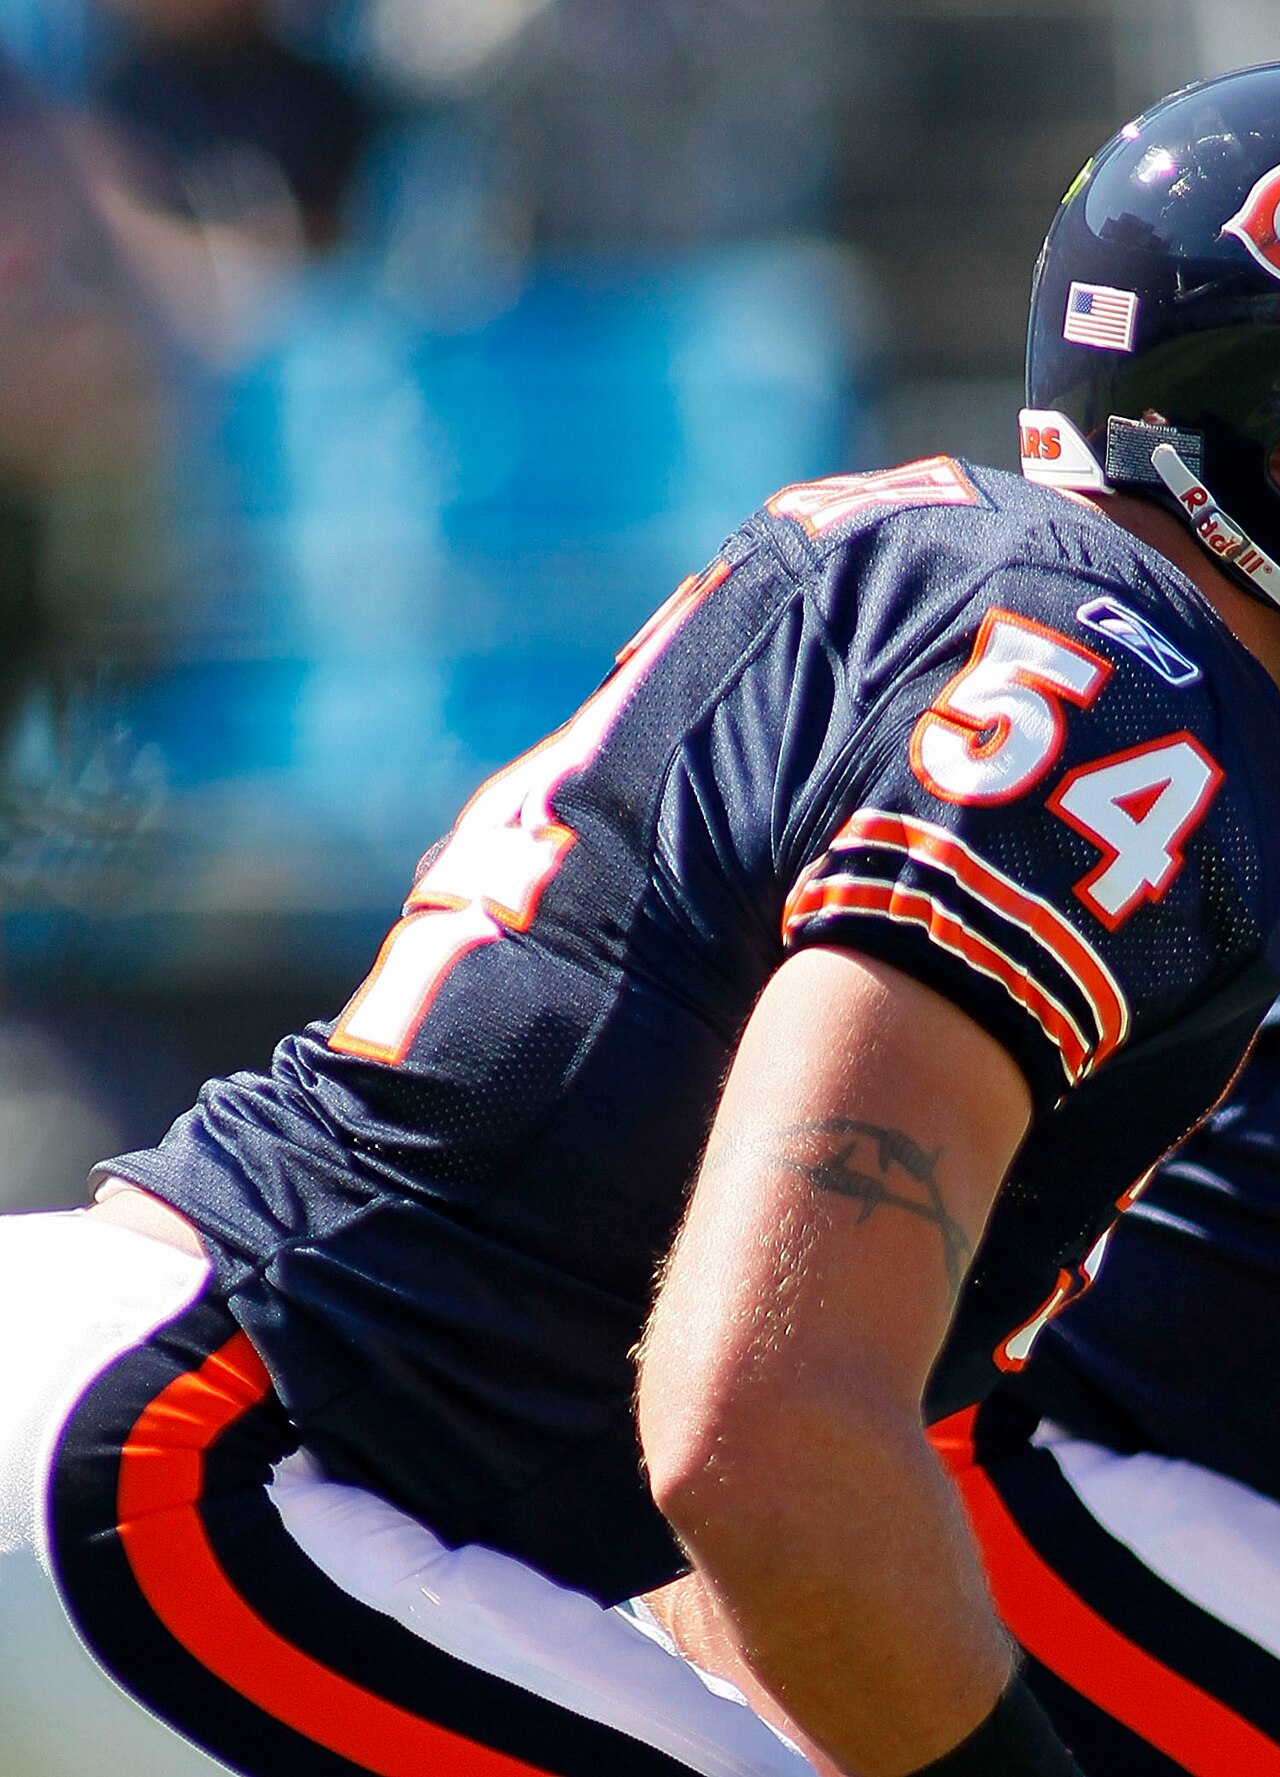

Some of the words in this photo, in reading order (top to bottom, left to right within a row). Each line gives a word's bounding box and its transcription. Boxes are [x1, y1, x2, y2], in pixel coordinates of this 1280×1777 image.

[1020, 426, 1061, 460] RS
[1180, 485, 1265, 574] Rddll
[909, 606, 1227, 933] 54
